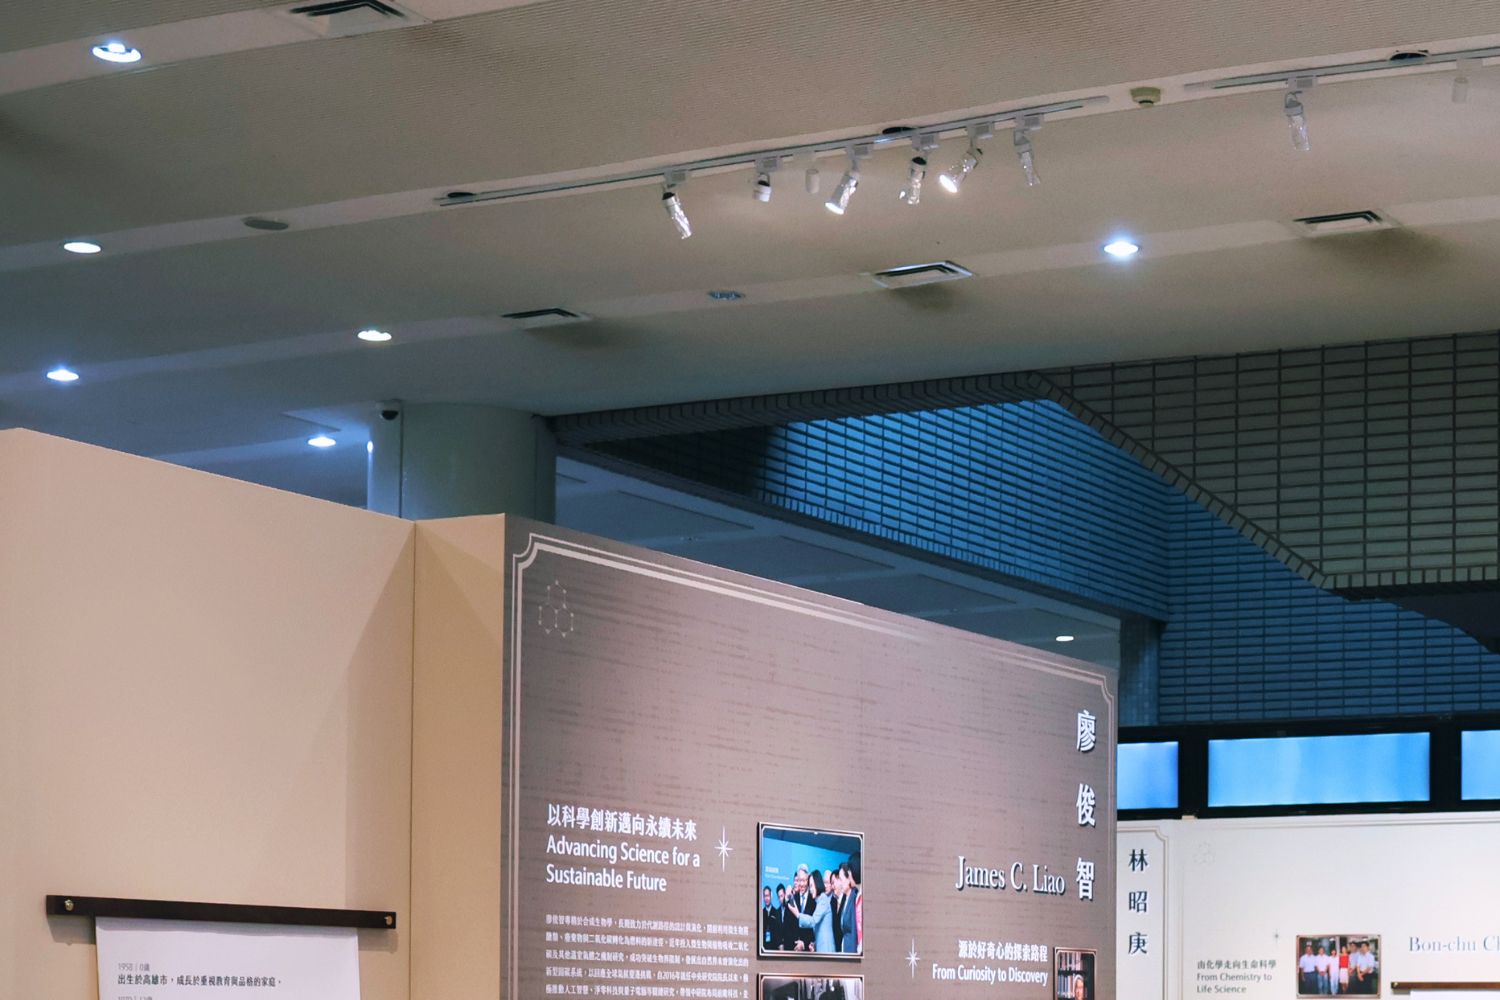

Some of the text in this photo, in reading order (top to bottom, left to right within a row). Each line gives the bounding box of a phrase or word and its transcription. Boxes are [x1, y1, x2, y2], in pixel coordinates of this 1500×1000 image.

[1077, 710, 1096, 901] 廖俊智
[547, 803, 698, 841] 以科學創新邁向永續未來
[546, 835, 701, 868] Advancing Science for a
[546, 864, 667, 892] Sustainable Future
[956, 856, 1066, 895] James C. Liao
[1127, 849, 1148, 955] 林昭庚
[958, 939, 1048, 962] 源於好奇心的探索路程
[1409, 936, 1476, 952] Bon-chu
[932, 963, 1048, 987] From Curiosity to Discovery
[1197, 960, 1276, 970] 由化學走向生命科學
[1197, 973, 1272, 983] From Chemistry to
[1197, 985, 1247, 994] Life Science
